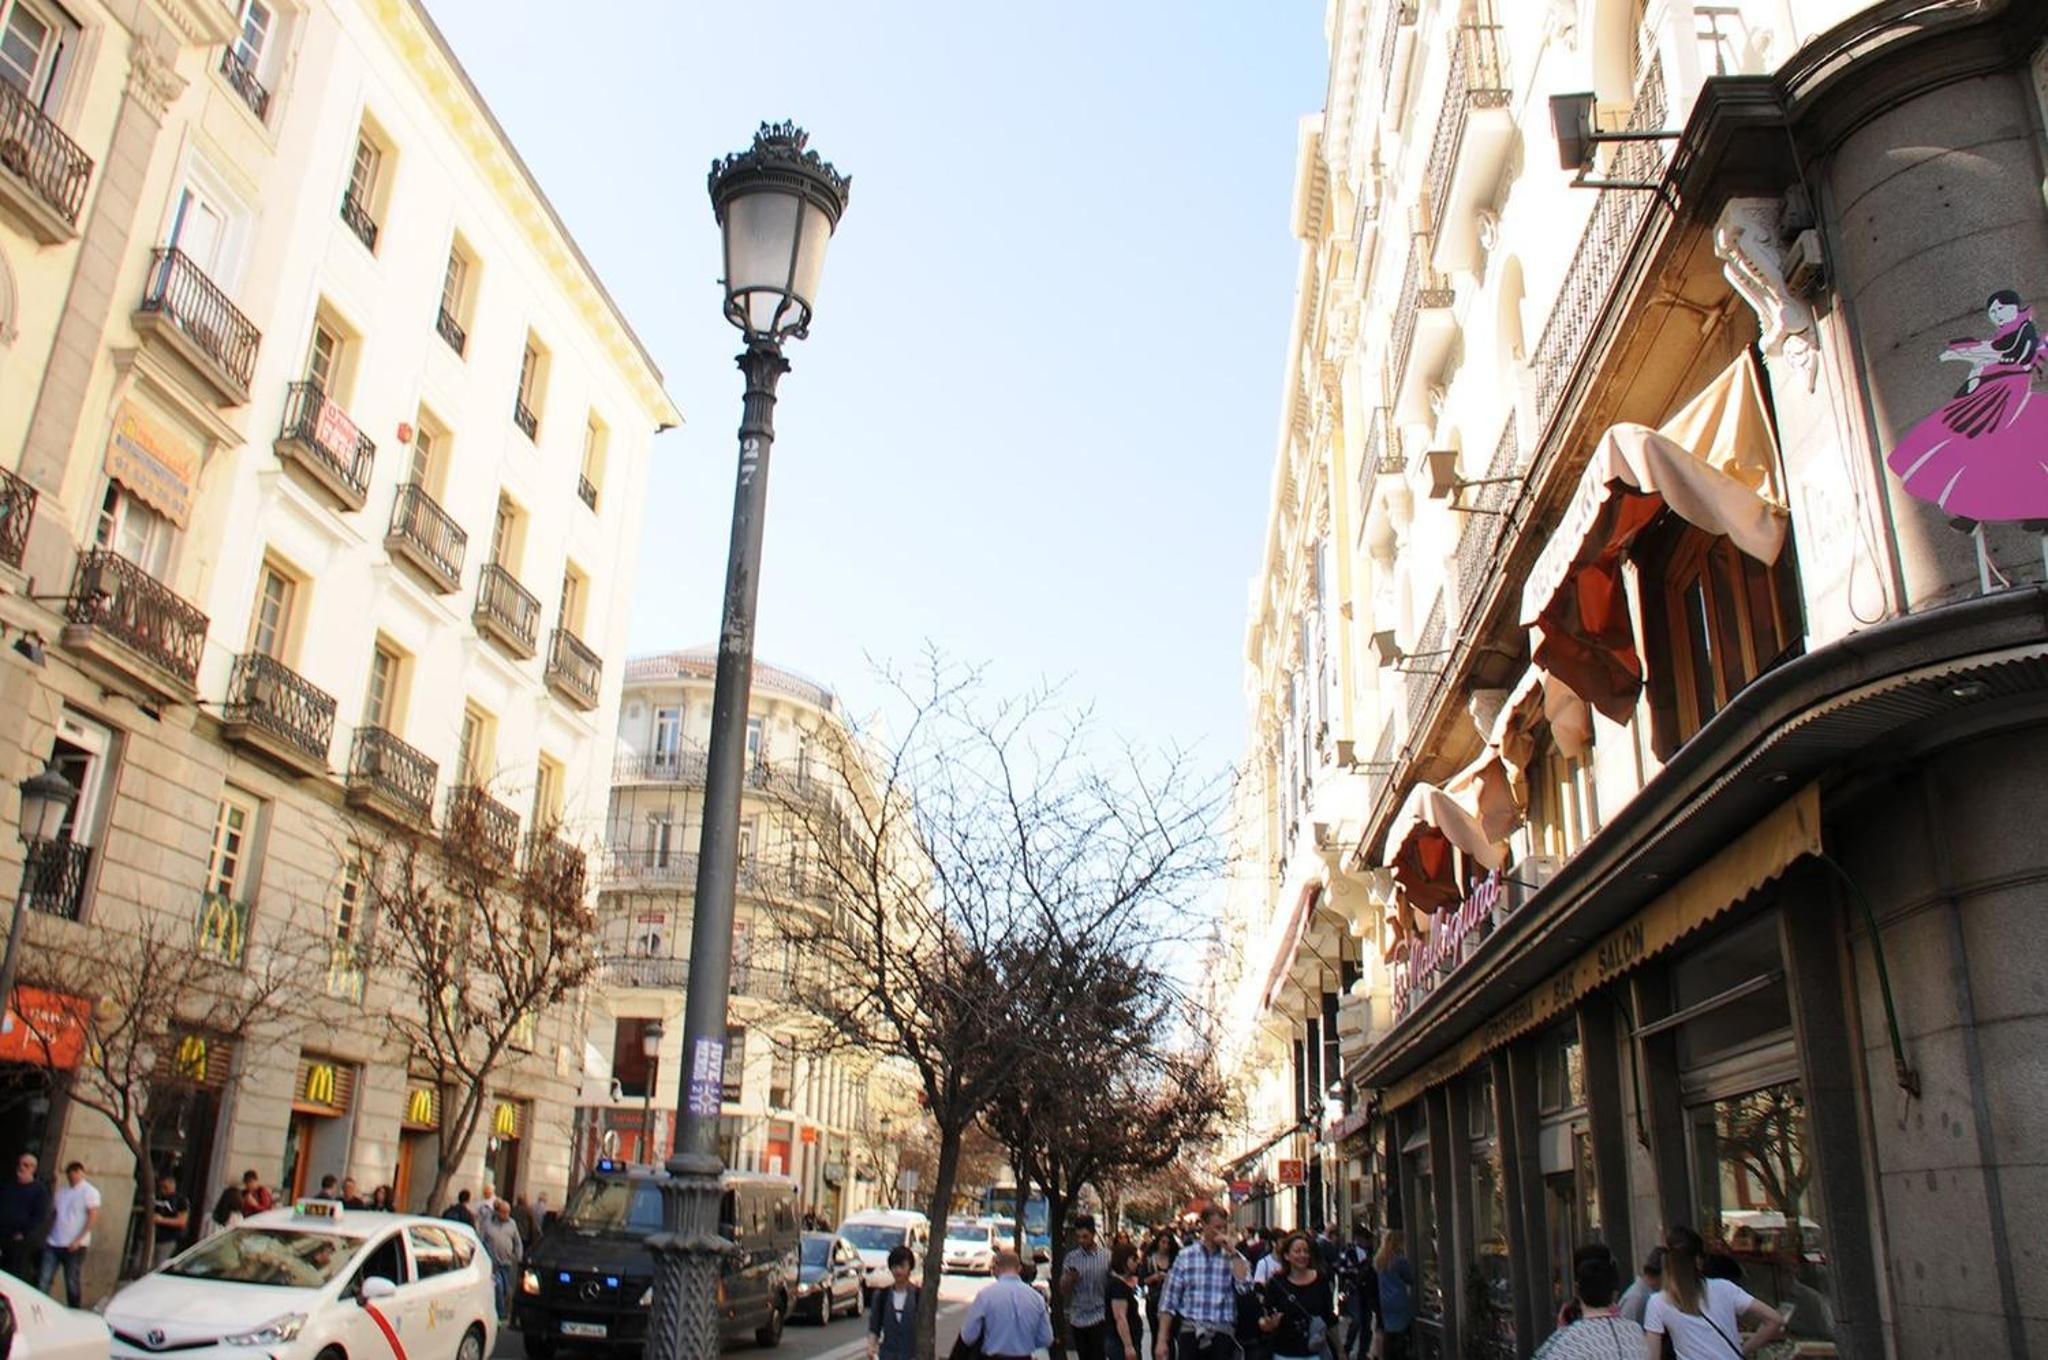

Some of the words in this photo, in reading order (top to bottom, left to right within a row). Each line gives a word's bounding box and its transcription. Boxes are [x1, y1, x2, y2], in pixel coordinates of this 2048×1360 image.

[1598, 920, 1645, 977] SALON
[305, 1064, 334, 1104] M
[408, 1089, 433, 1125] M
[495, 1102, 516, 1135] M
